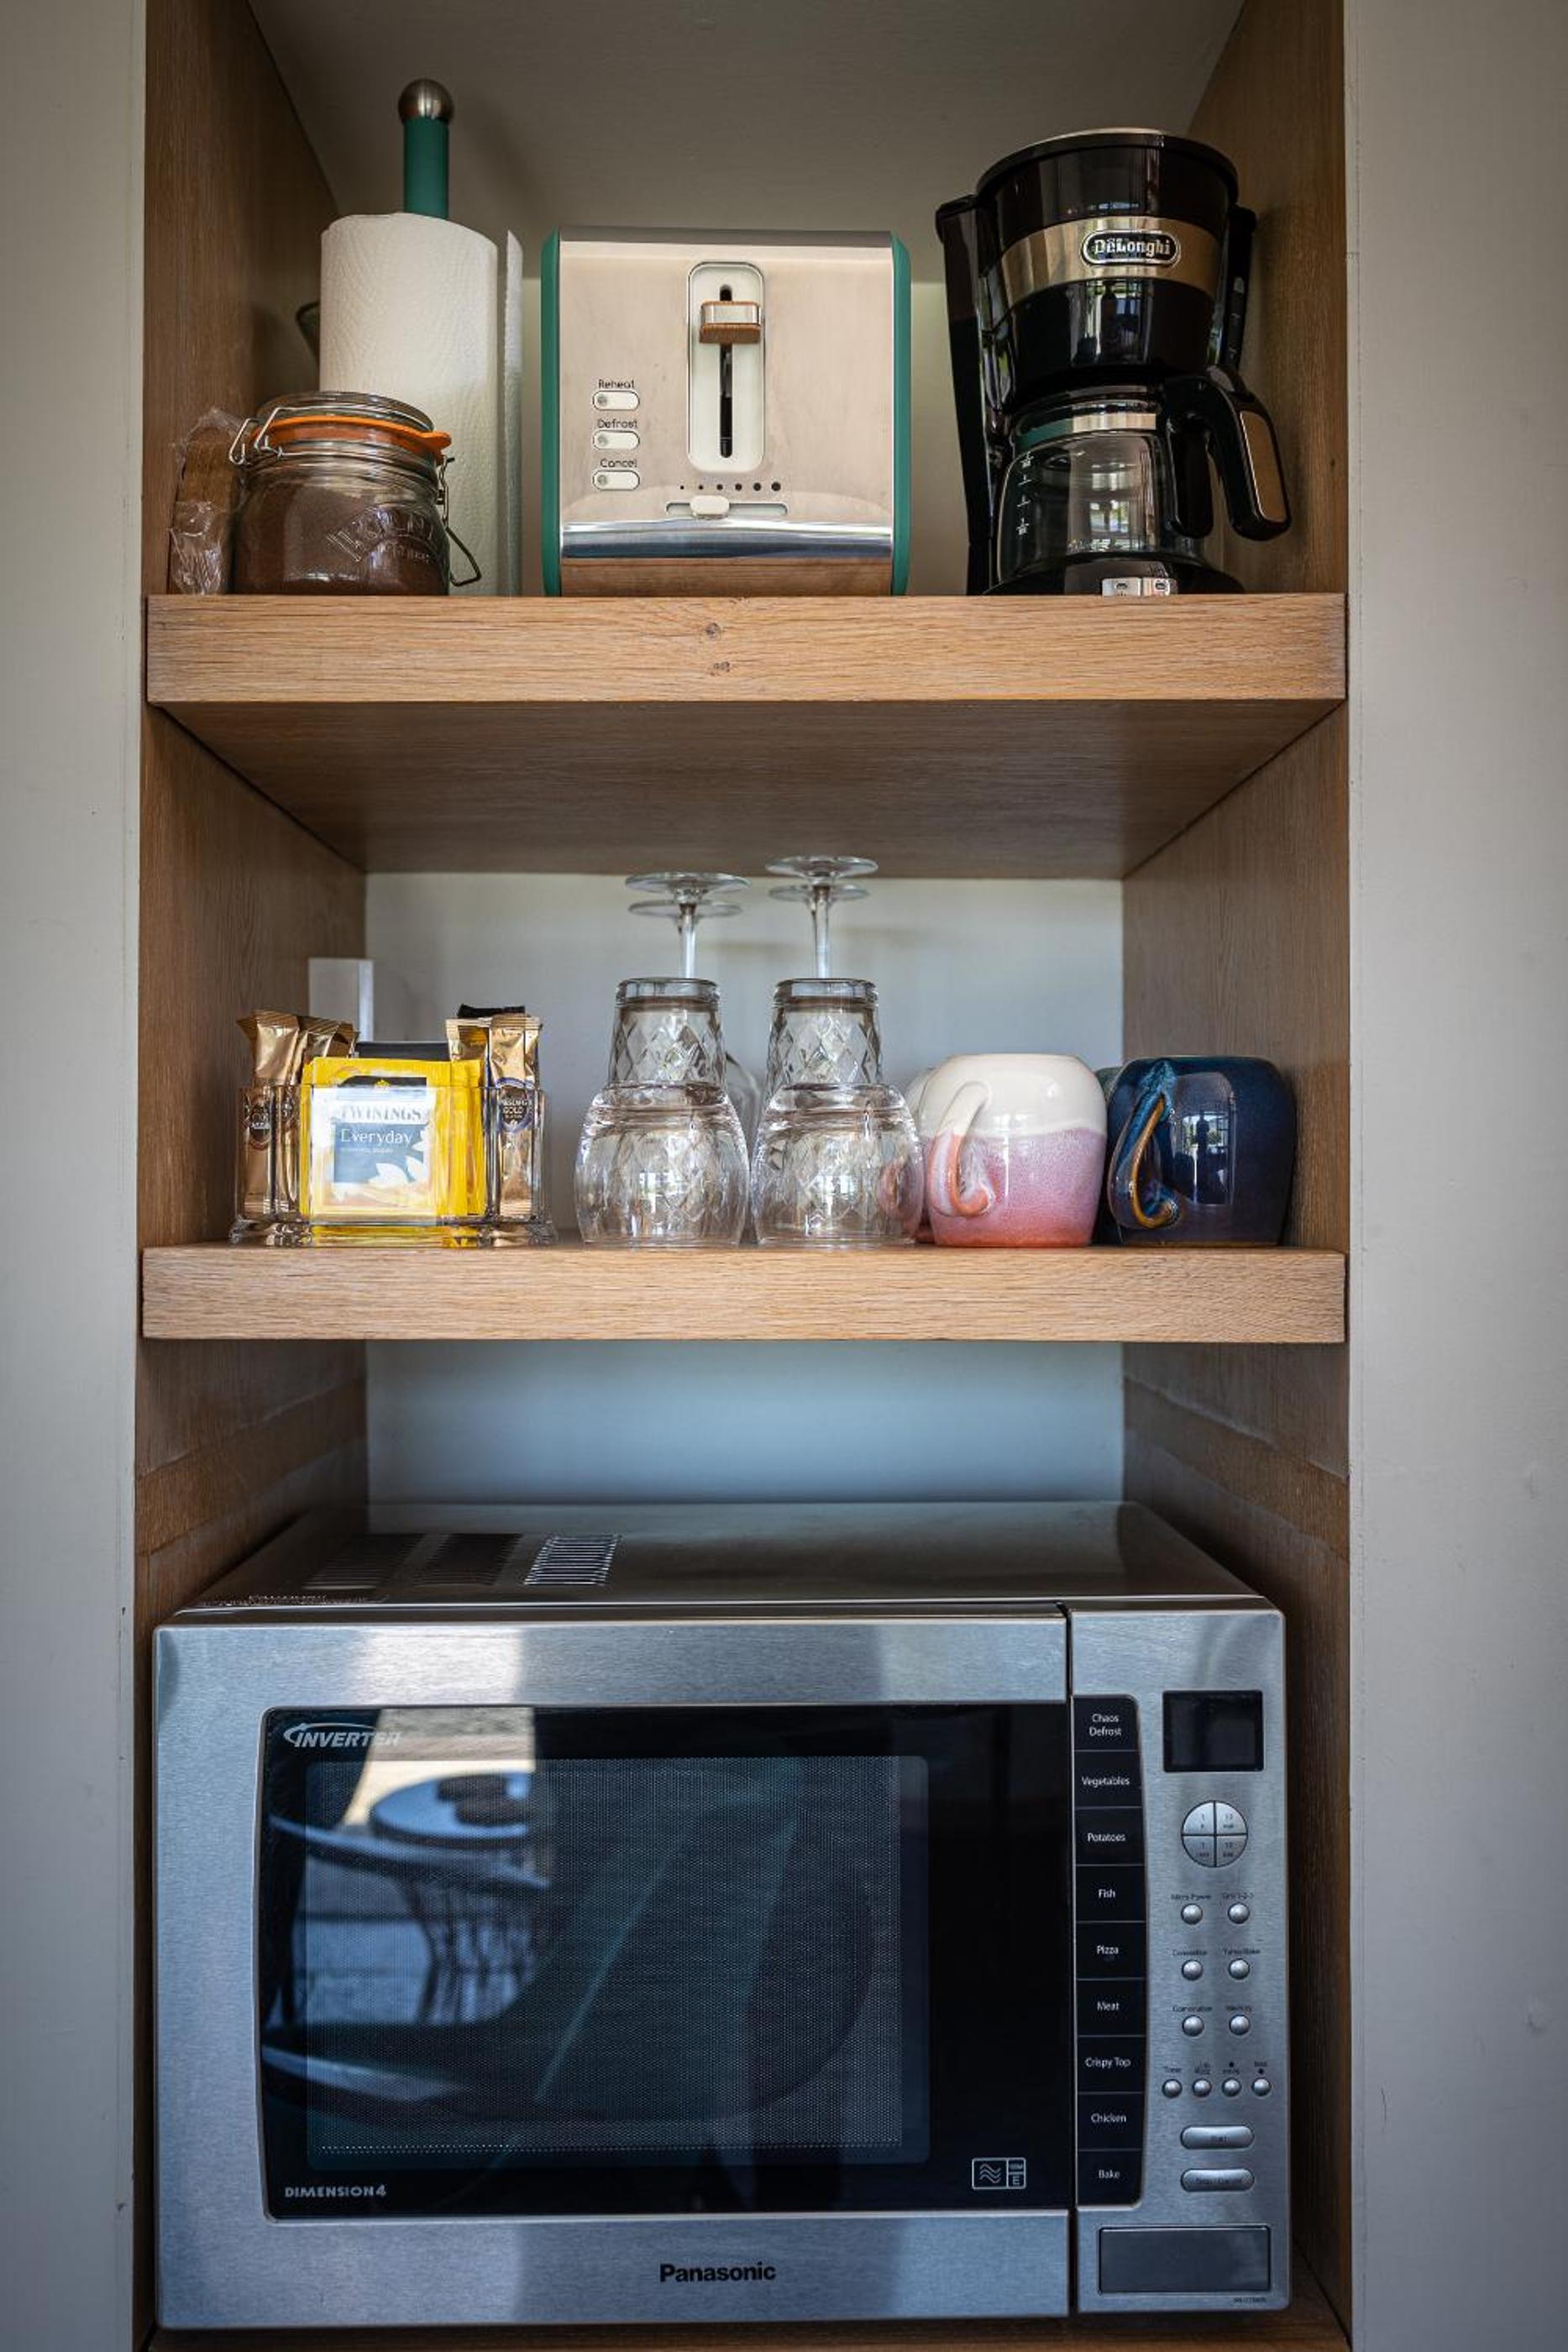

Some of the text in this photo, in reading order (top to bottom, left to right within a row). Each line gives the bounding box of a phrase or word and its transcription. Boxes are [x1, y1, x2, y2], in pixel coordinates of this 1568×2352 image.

[599, 379, 634, 389] Reheat
[597, 418, 637, 428] Defrost
[600, 458, 637, 468] Cancel
[338, 1105, 422, 1121] TWININGS
[341, 1128, 413, 1147] Everyday
[1092, 1714, 1120, 1723] Chaos
[1089, 1726, 1122, 1736] Defrost
[294, 1731, 402, 1748] INVERTER
[1082, 1776, 1130, 1788] Vegetables
[1088, 1833, 1126, 1842] Potatoes
[1098, 1888, 1116, 1898] Fish
[1096, 1945, 1120, 1955] Pizza
[1097, 2001, 1120, 2011] Meat
[1085, 2057, 1131, 2069] Crispy Top
[1091, 2113, 1127, 2123] Chicken
[1098, 2170, 1120, 2179] Bake
[659, 2261, 777, 2282] Panasonic
